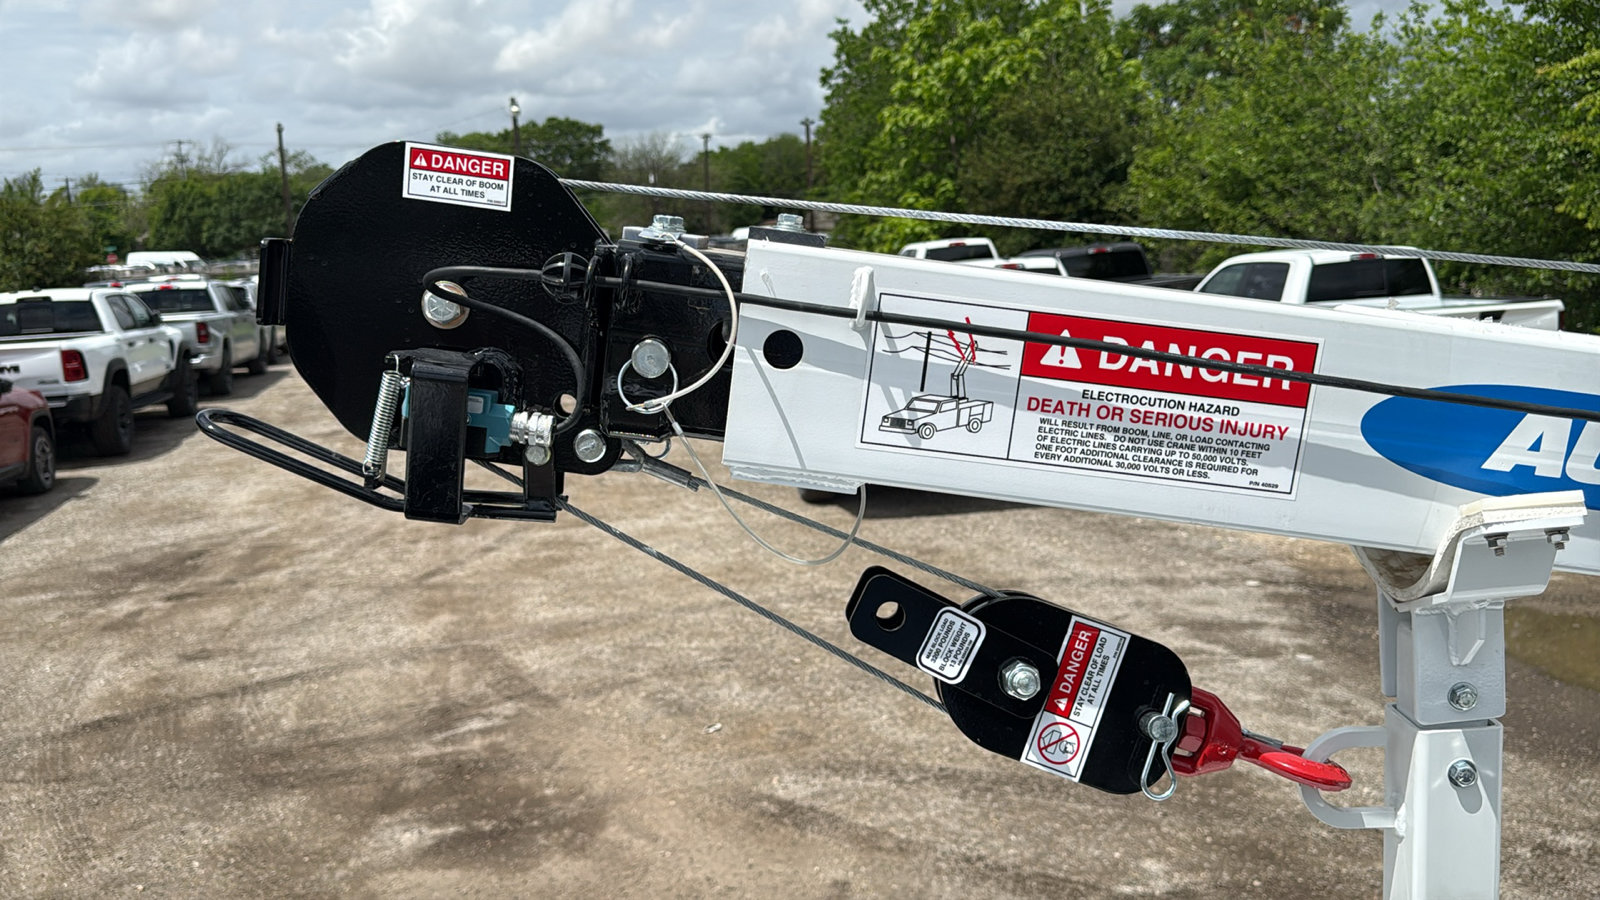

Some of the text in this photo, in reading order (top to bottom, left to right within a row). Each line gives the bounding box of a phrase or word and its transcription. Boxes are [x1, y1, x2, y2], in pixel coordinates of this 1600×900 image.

[432, 154, 504, 176] DANGER
[412, 172, 504, 191] STAY CLEAR OF BOOM
[443, 187, 458, 195] ALL
[461, 189, 485, 198] TIMES
[1098, 335, 1294, 390] DANGER
[1082, 389, 1240, 416] ELECTROCUTION HAZARD
[1027, 396, 1289, 441] DEATH OR SERIOUS INJURY
[1038, 426, 1262, 459] ELECTRIC LINES. DO NOT USE CRANE WITHIN 10 FEET
[1040, 418, 1270, 451] WILL RESULT FROM BOOM, LINE, OR LOAD CONTACTING
[1034, 452, 1210, 479] EVERY ADDITIONAL 30,000 VOLTS OR LESS.
[1036, 443, 1053, 452] ONE
[1055, 446, 1078, 454] FOOT
[1080, 449, 1129, 461] ADDITIONAL
[1132, 455, 1183, 467] CLEARANCE
[1195, 462, 1239, 474] REQUIRED
[1241, 467, 1258, 476] FOR
[1050, 436, 1090, 447] ELECTRIC
[1092, 441, 1116, 450] LINES
[1118, 443, 1162, 456] CARRYING
[1192, 453, 1217, 463] 50,000
[1219, 456, 1248, 466] VOLTS.
[933, 633, 942, 648] BLOCK
[940, 618, 948, 632] LOAD
[938, 620, 956, 648] POUNDS
[939, 648, 953, 671] BLOCK
[951, 622, 967, 648] WEIGHT
[953, 632, 970, 659] POUNDS
[1059, 630, 1092, 694] DANGER
[1073, 636, 1107, 717] STAY CLEAR OF LOAD
[1088, 655, 1110, 705] AT ALL TIMES
